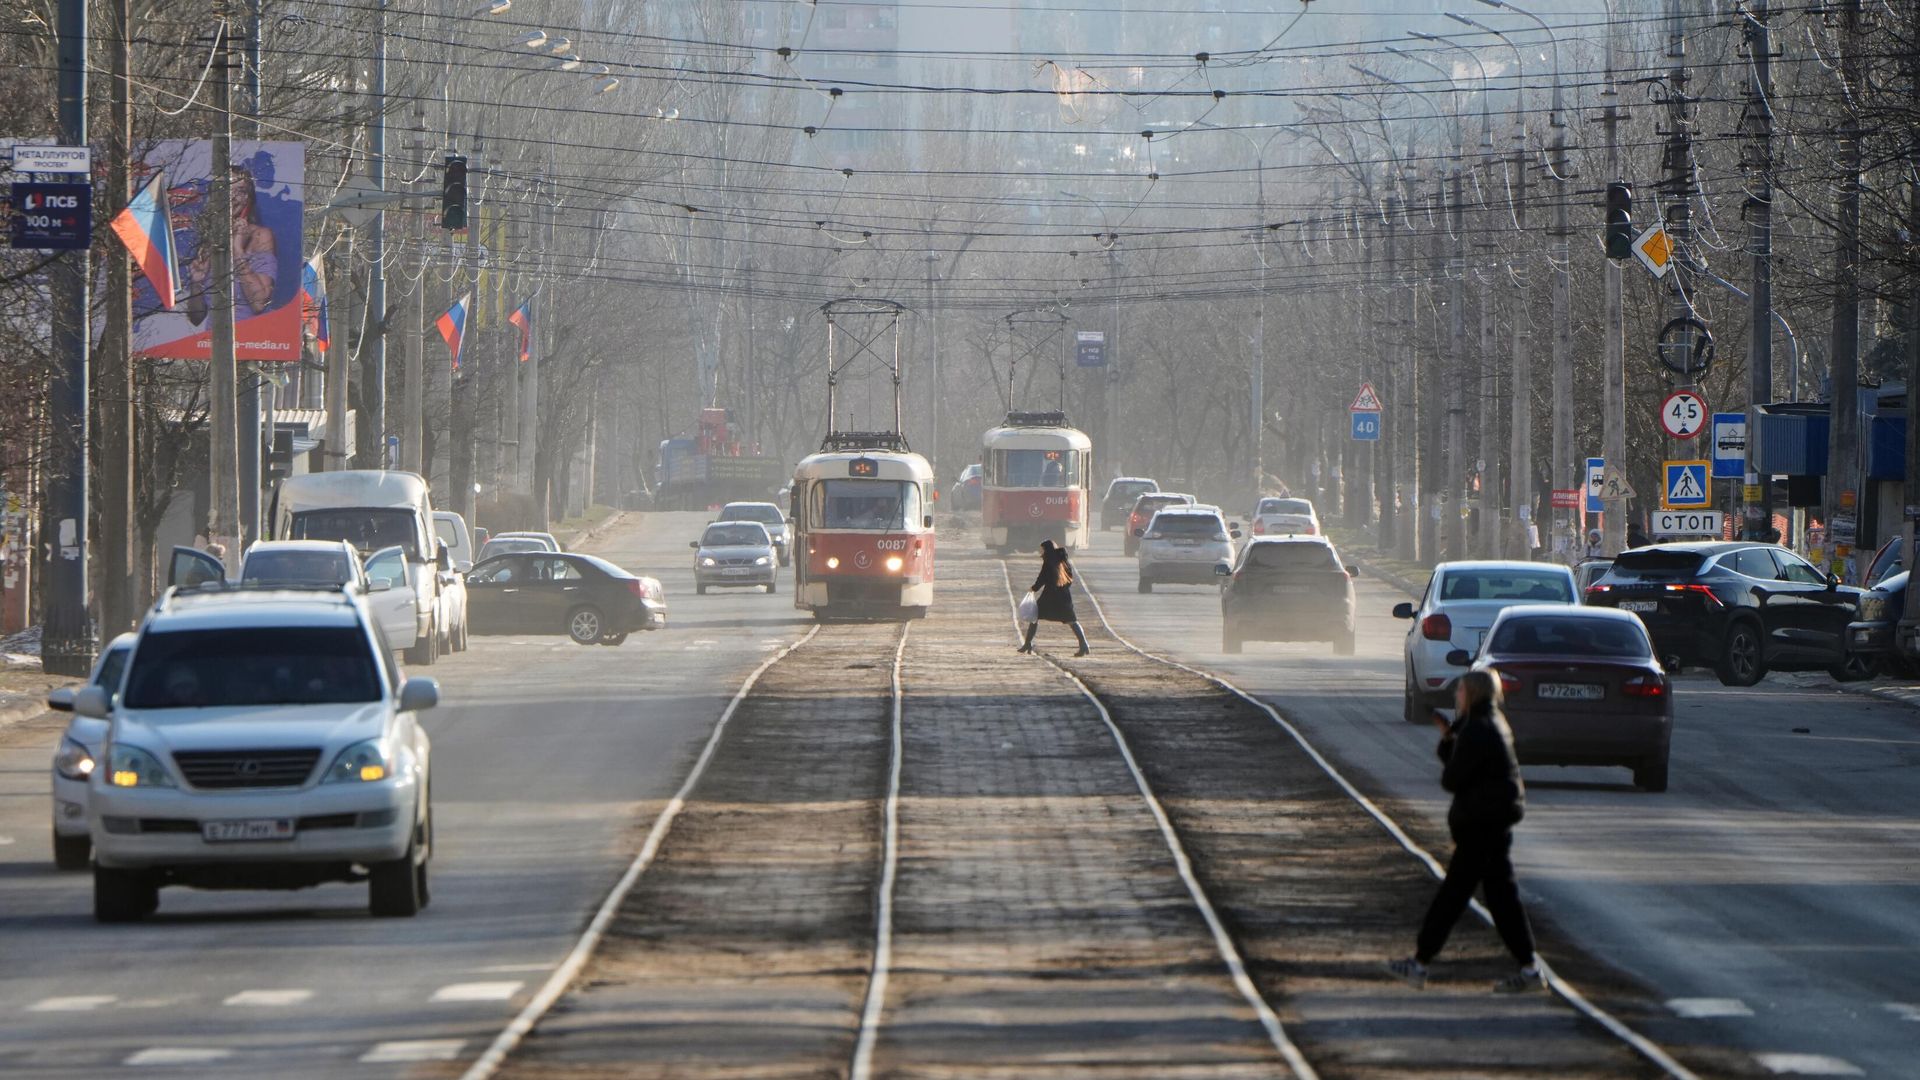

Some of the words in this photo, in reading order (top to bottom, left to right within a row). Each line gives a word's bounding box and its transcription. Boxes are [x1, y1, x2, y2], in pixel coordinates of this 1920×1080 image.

[17, 150, 86, 160] МЕТАЛЛУРГОВ
[45, 195, 78, 208] ПСБ
[26, 215, 50, 227] 100
[1357, 421, 1374, 433] 40
[1661, 515, 1714, 530] СТОП
[877, 539, 907, 551] 0087
